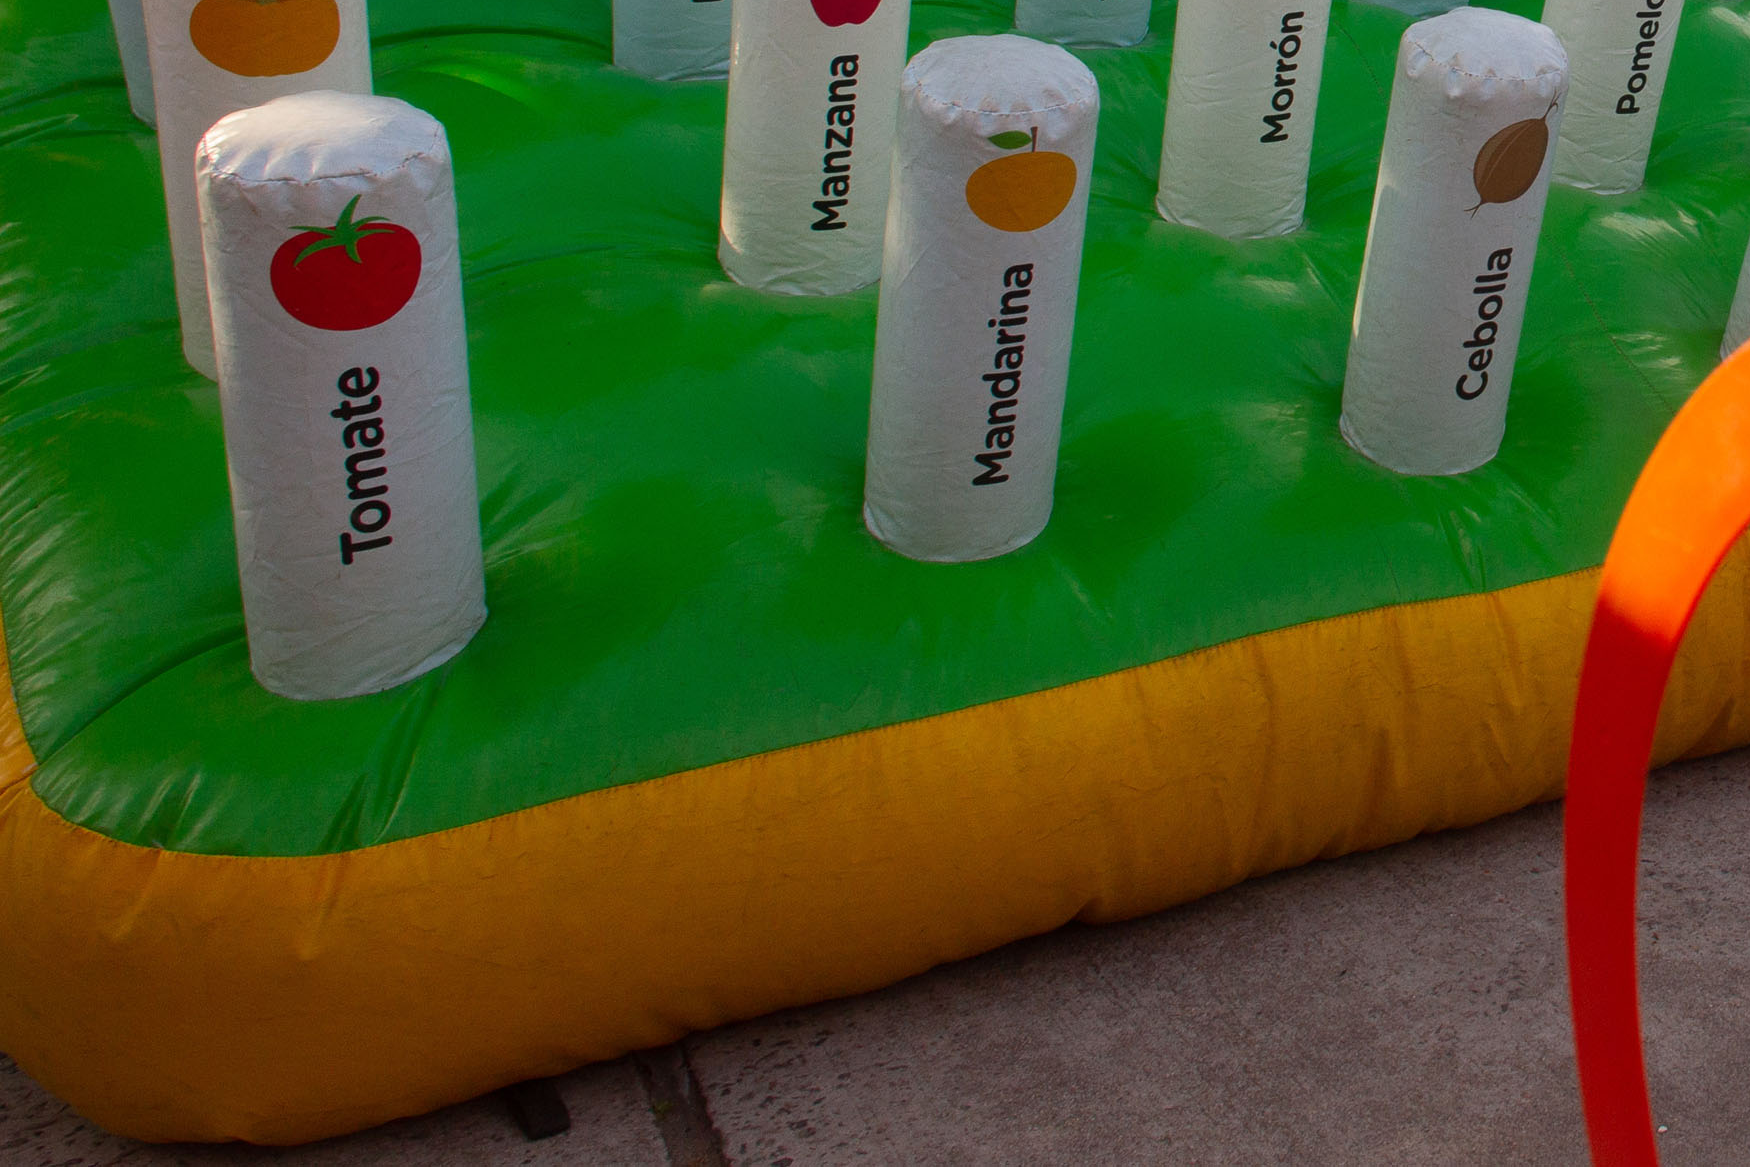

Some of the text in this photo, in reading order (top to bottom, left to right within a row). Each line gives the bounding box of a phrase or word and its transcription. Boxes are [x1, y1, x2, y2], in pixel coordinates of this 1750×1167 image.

[811, 54, 859, 231] Manzana
[1260, 11, 1304, 143] Morrón
[972, 263, 1034, 487] Mandarina
[1455, 247, 1514, 402] Cebolla
[331, 365, 393, 566] Tomate
